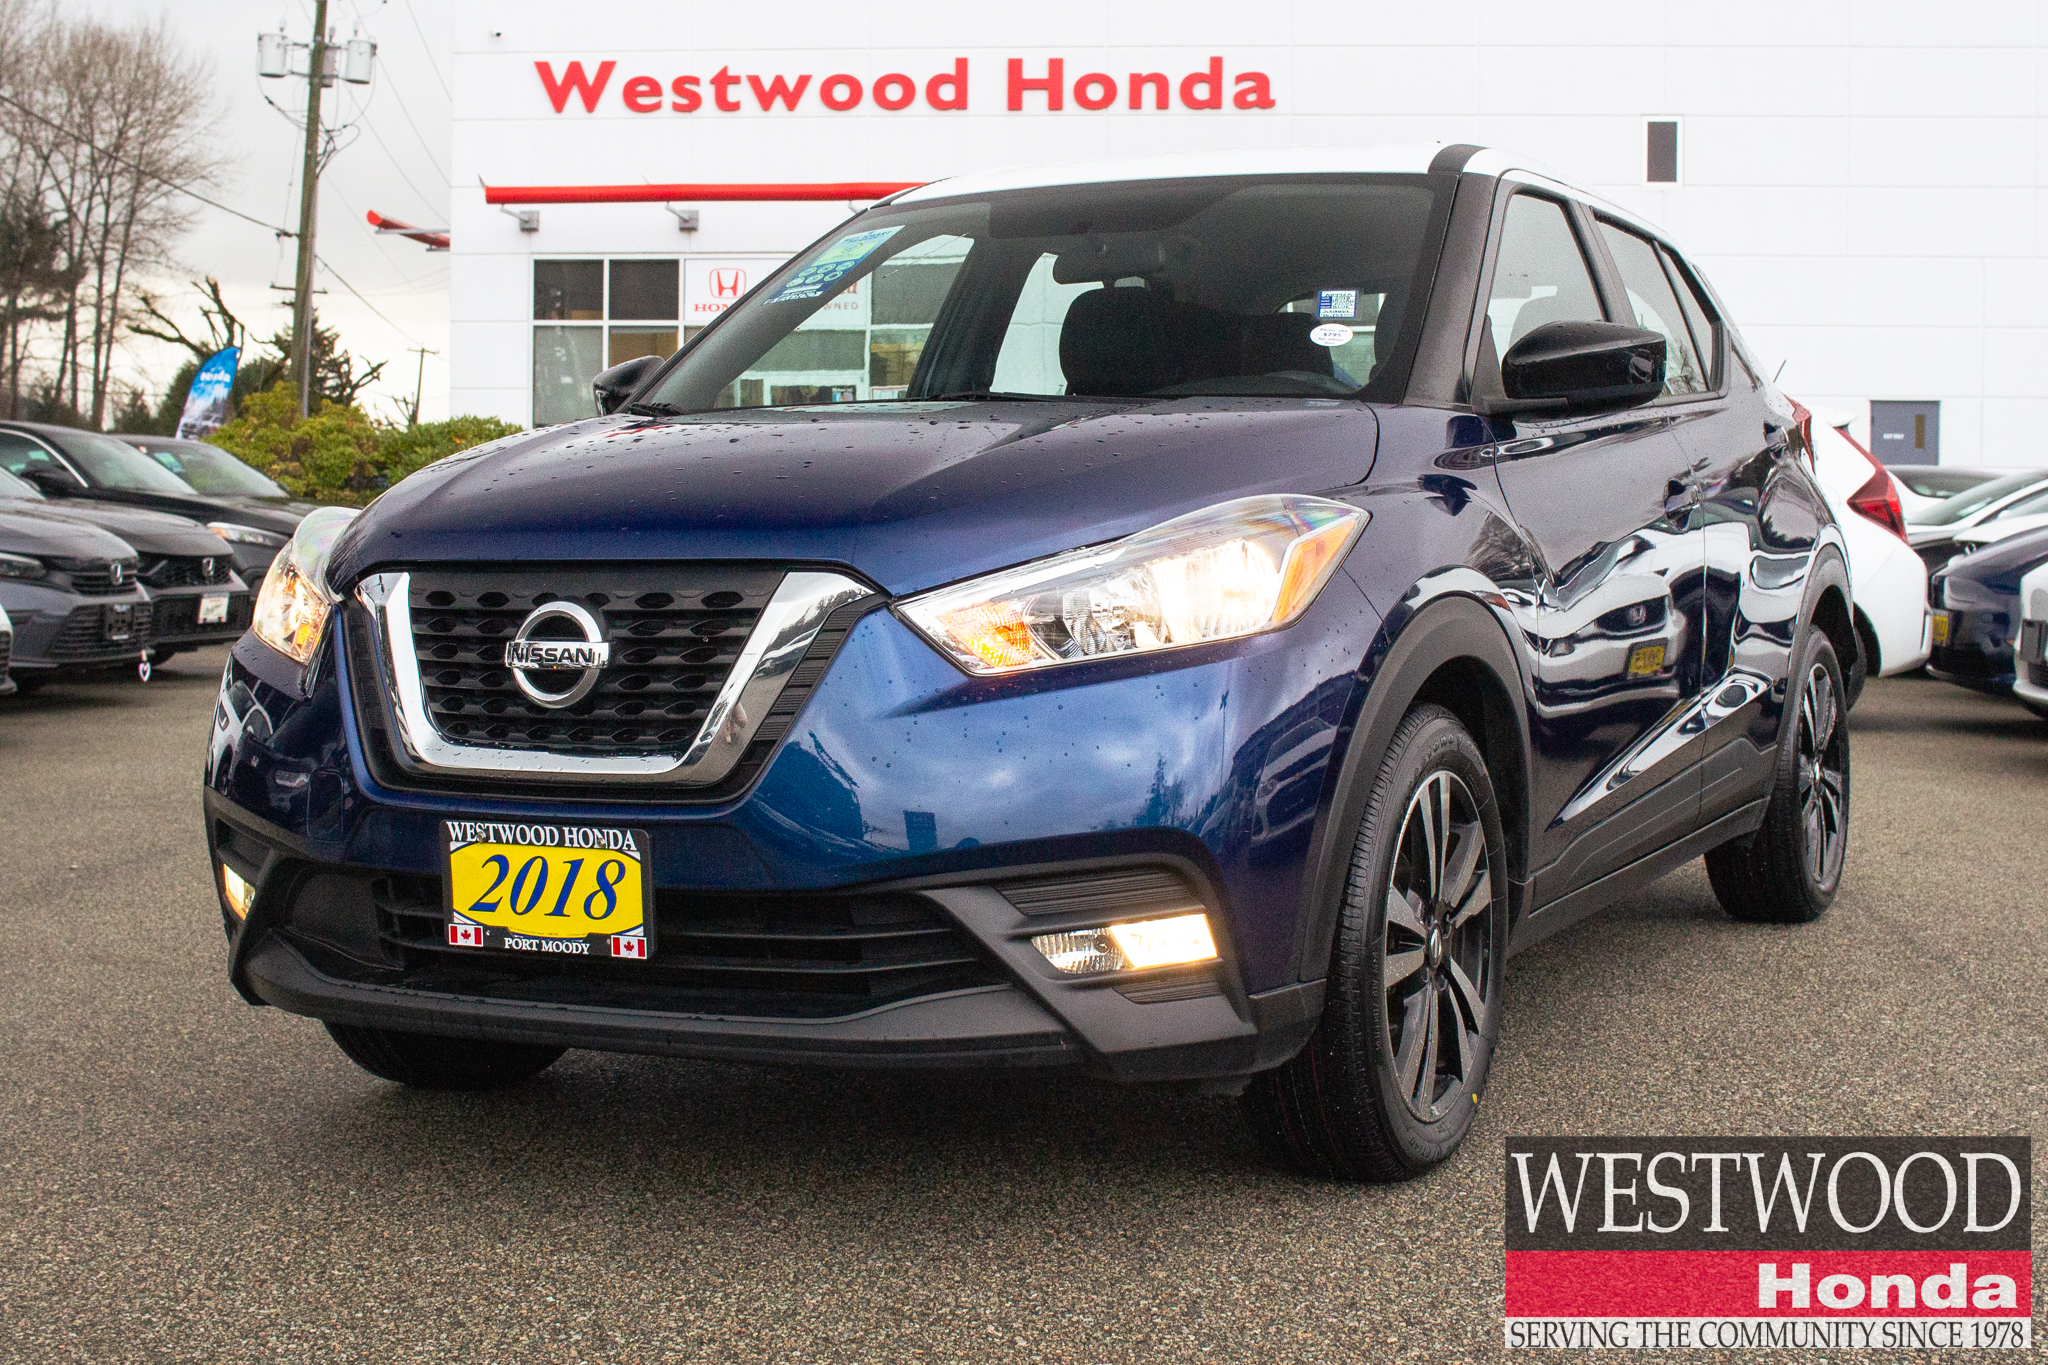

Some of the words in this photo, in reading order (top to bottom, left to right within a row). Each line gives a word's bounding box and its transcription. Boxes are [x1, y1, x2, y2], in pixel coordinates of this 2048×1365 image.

[534, 57, 969, 113] Westwood
[1006, 56, 1276, 111] Honda
[694, 303, 729, 312] HON
[823, 301, 859, 311] WNED
[511, 647, 593, 663] NISSAN
[446, 821, 559, 847] WESTWOOD
[562, 826, 638, 851] HONDA
[467, 854, 627, 921] 2018
[503, 937, 539, 951] PORT
[541, 940, 590, 955] MOODY
